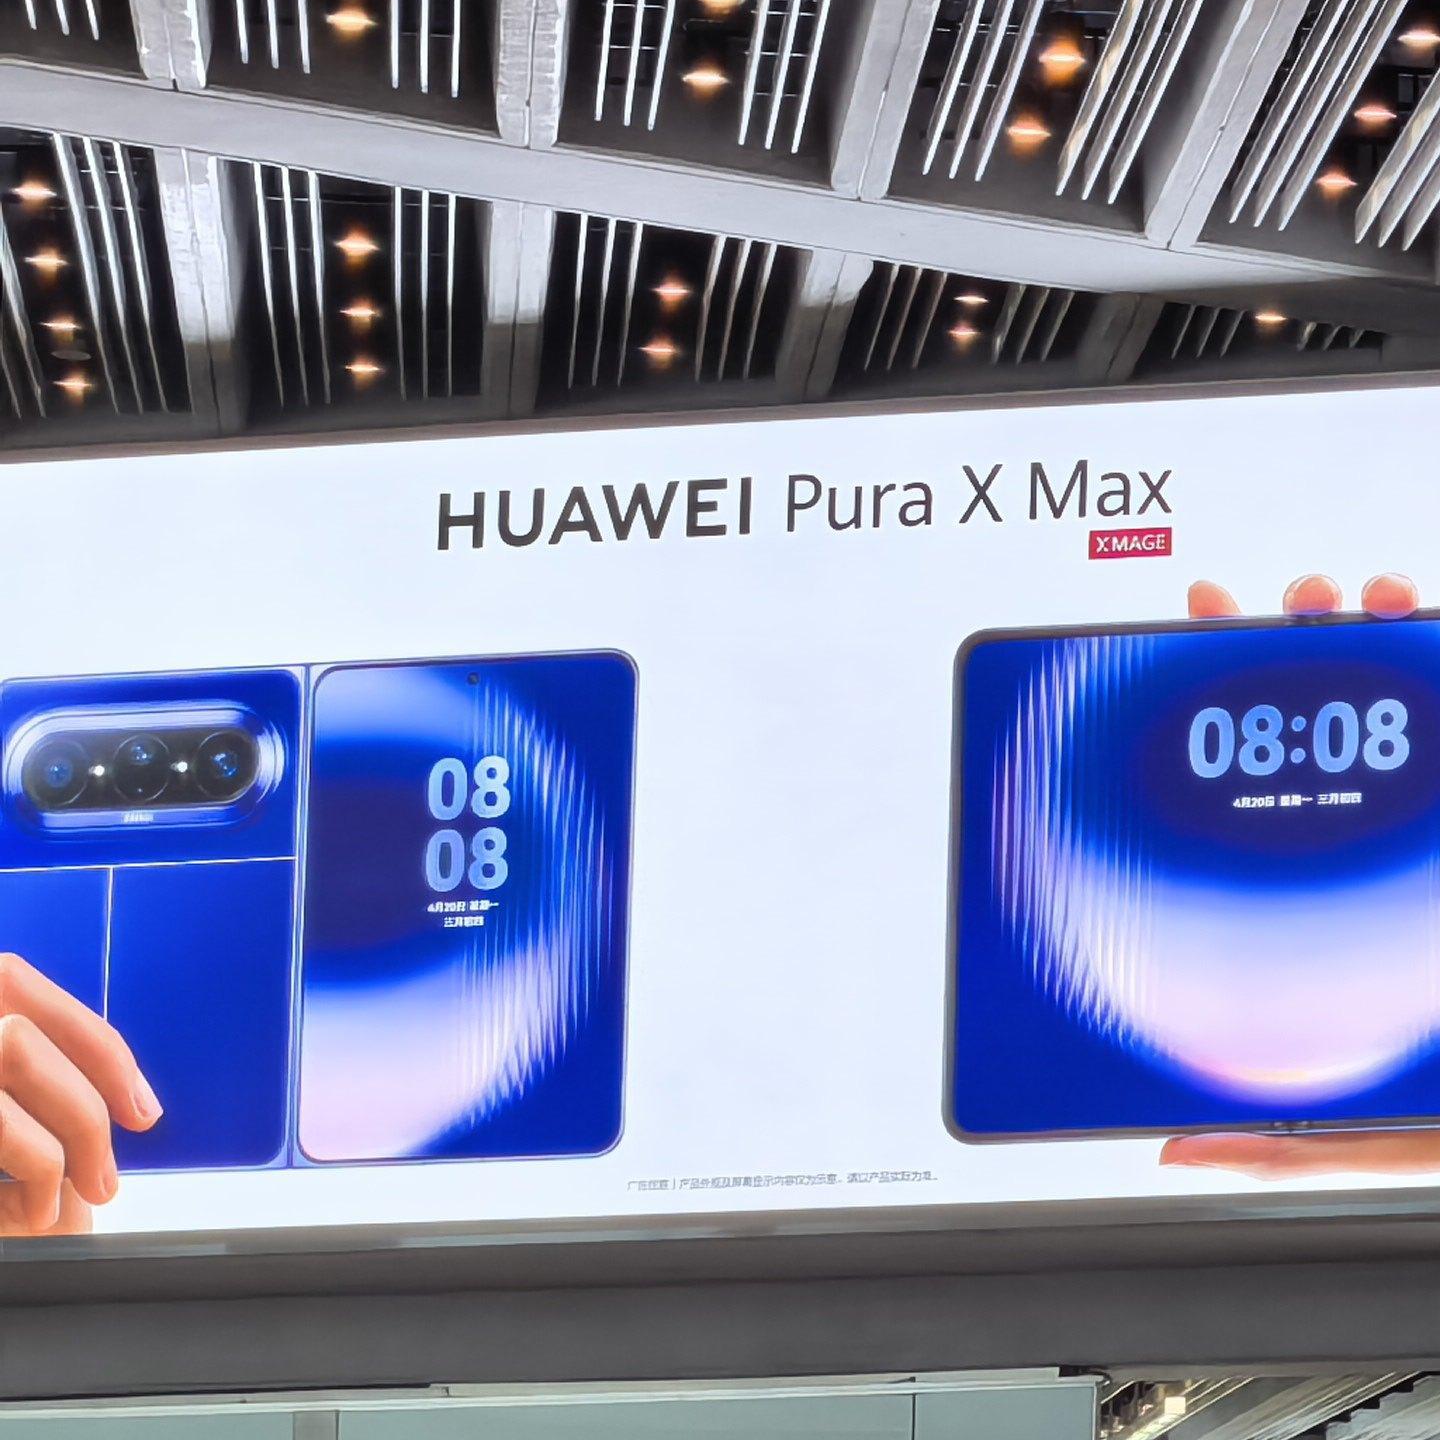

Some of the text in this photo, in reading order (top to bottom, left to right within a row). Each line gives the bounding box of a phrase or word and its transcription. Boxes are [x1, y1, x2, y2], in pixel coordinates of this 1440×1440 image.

[436, 458, 1173, 551] HUAWEI Pura X Max
[1095, 533, 1167, 556] XMAGE
[1188, 698, 1410, 779] 08:08
[427, 755, 511, 821] 08
[425, 826, 509, 893] 08
